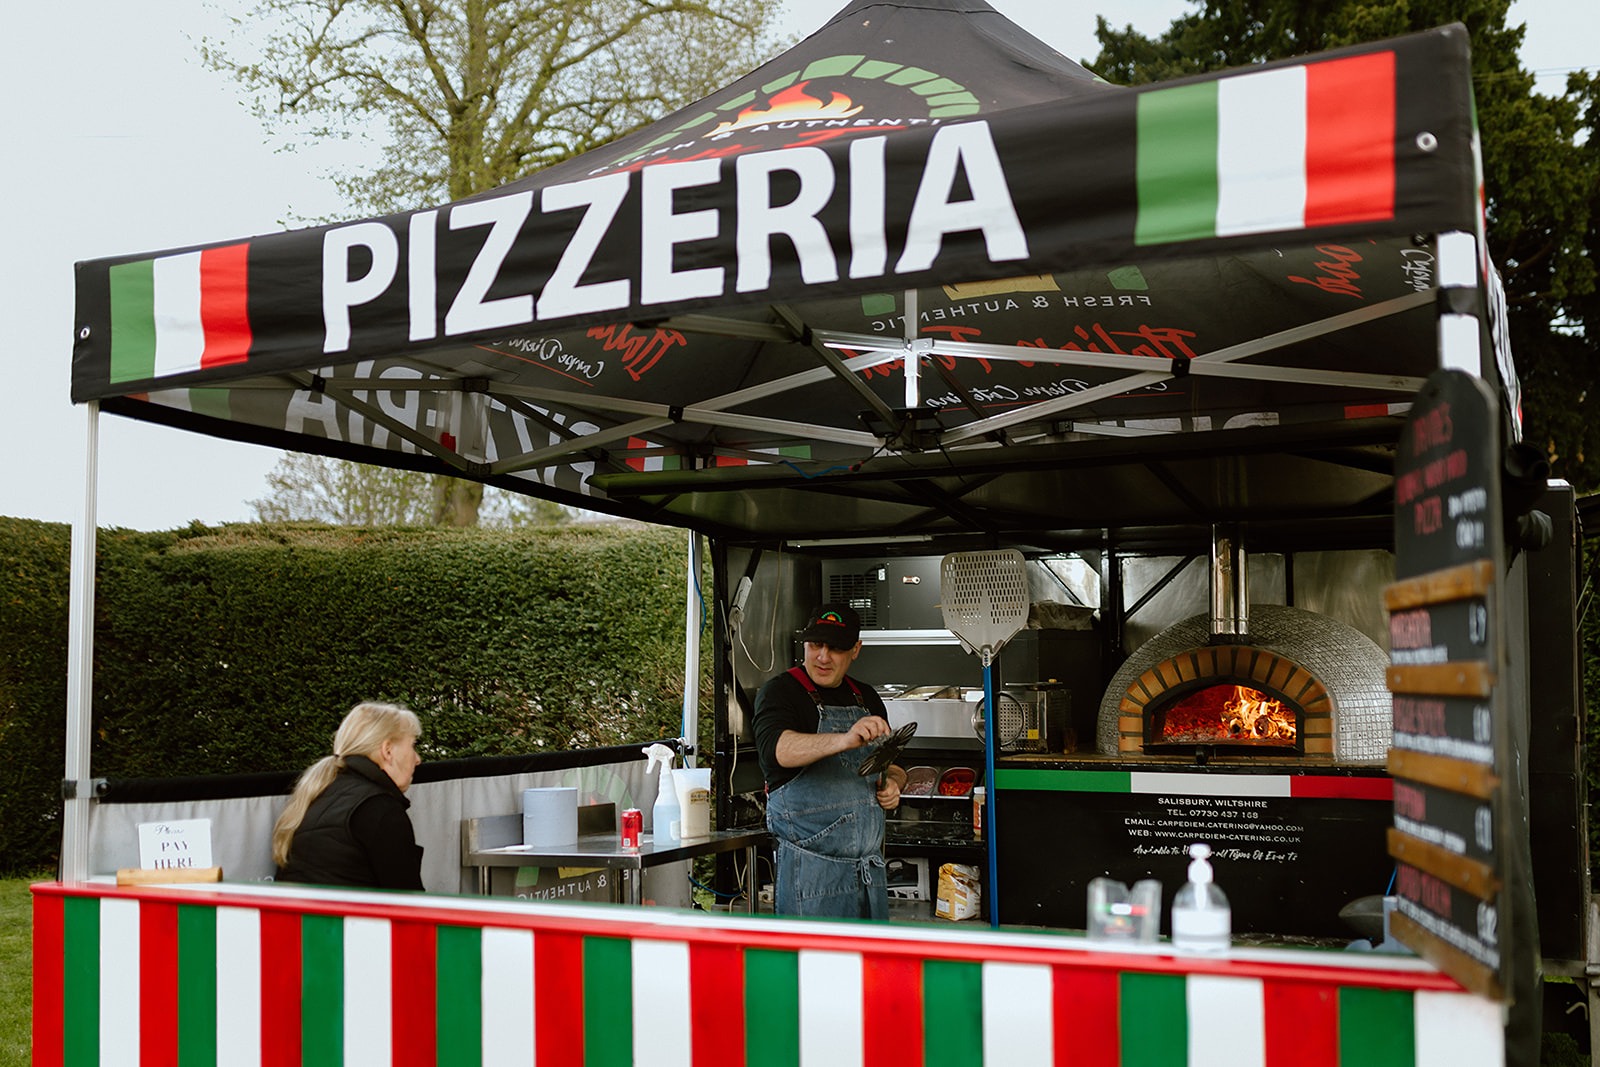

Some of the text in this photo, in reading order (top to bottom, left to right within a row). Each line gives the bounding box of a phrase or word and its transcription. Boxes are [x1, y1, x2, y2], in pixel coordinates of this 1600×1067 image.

[750, 119, 942, 134] AUTHENTI
[322, 120, 1030, 354] PIZZERIA
[1157, 797, 1268, 808] SALISBURY, WILTSHIRE
[1166, 808, 1187, 817] TEL.
[1189, 809, 1219, 818] 07730
[1220, 810, 1239, 819] 437
[1124, 818, 1304, 832] EMAIL: CARPEDIEM.CATERING@YAHOO.COM
[1128, 829, 1301, 843] WEB: WWW.CARPEDIEM-CATERING.CO.UK
[161, 840, 188, 853] PAY
